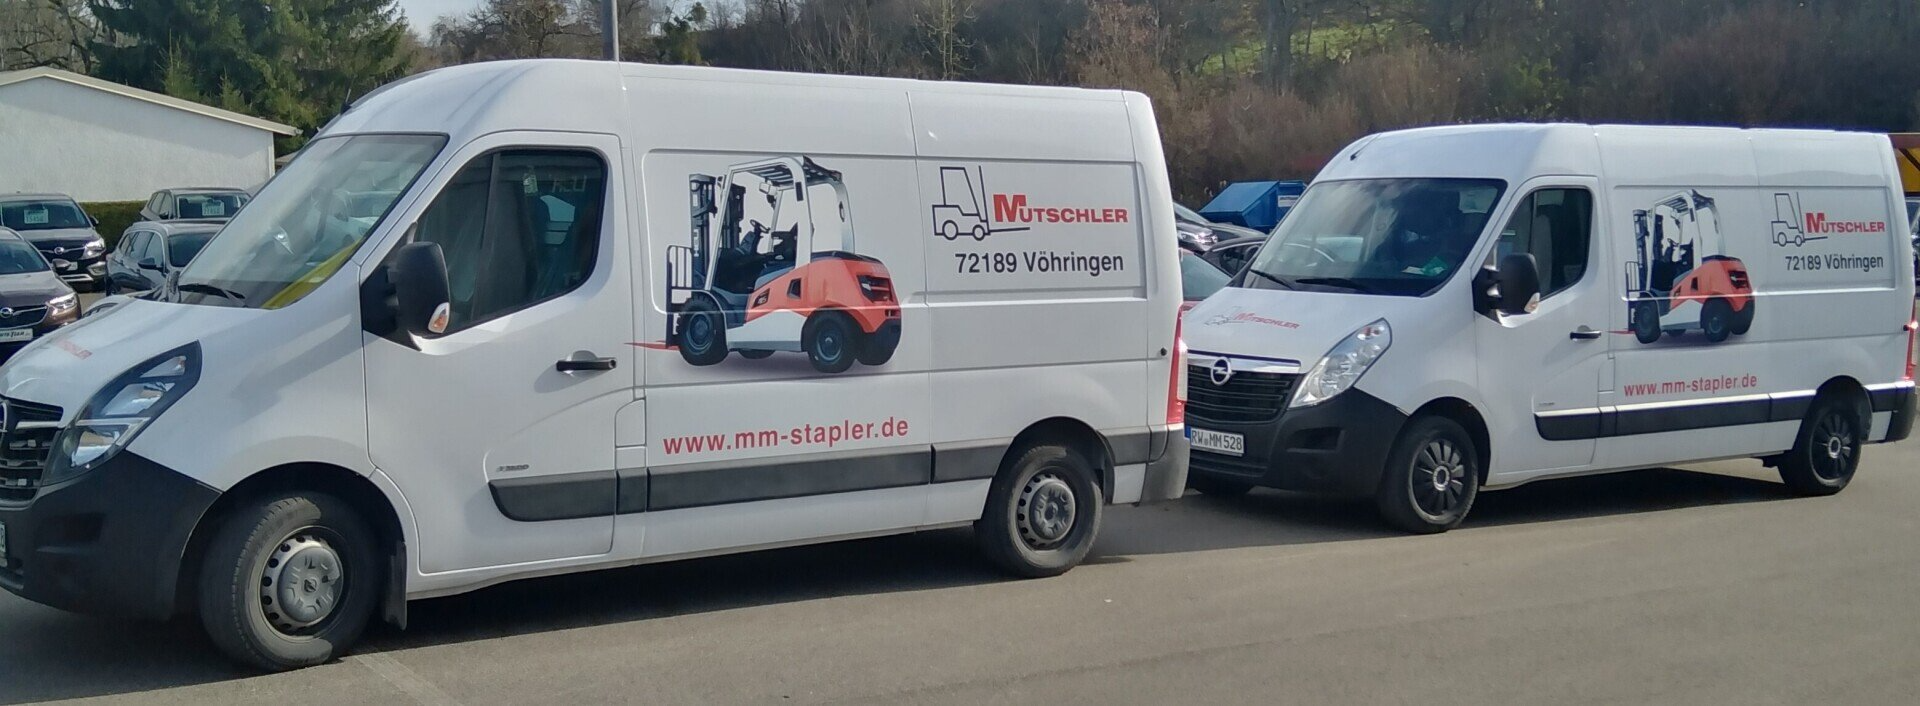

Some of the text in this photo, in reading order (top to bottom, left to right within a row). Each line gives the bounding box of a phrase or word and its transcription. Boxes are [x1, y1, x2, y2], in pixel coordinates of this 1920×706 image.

[993, 194, 1128, 223] MUTSCHLER
[1805, 212, 1885, 233] MUTSCHLER
[954, 251, 1124, 277] 72189 Vöhringen
[1785, 254, 1884, 272] 72189 Vöhringen
[1623, 373, 1757, 396] www.mm-stapler.de
[663, 416, 909, 455] www.mm-stapler.de
